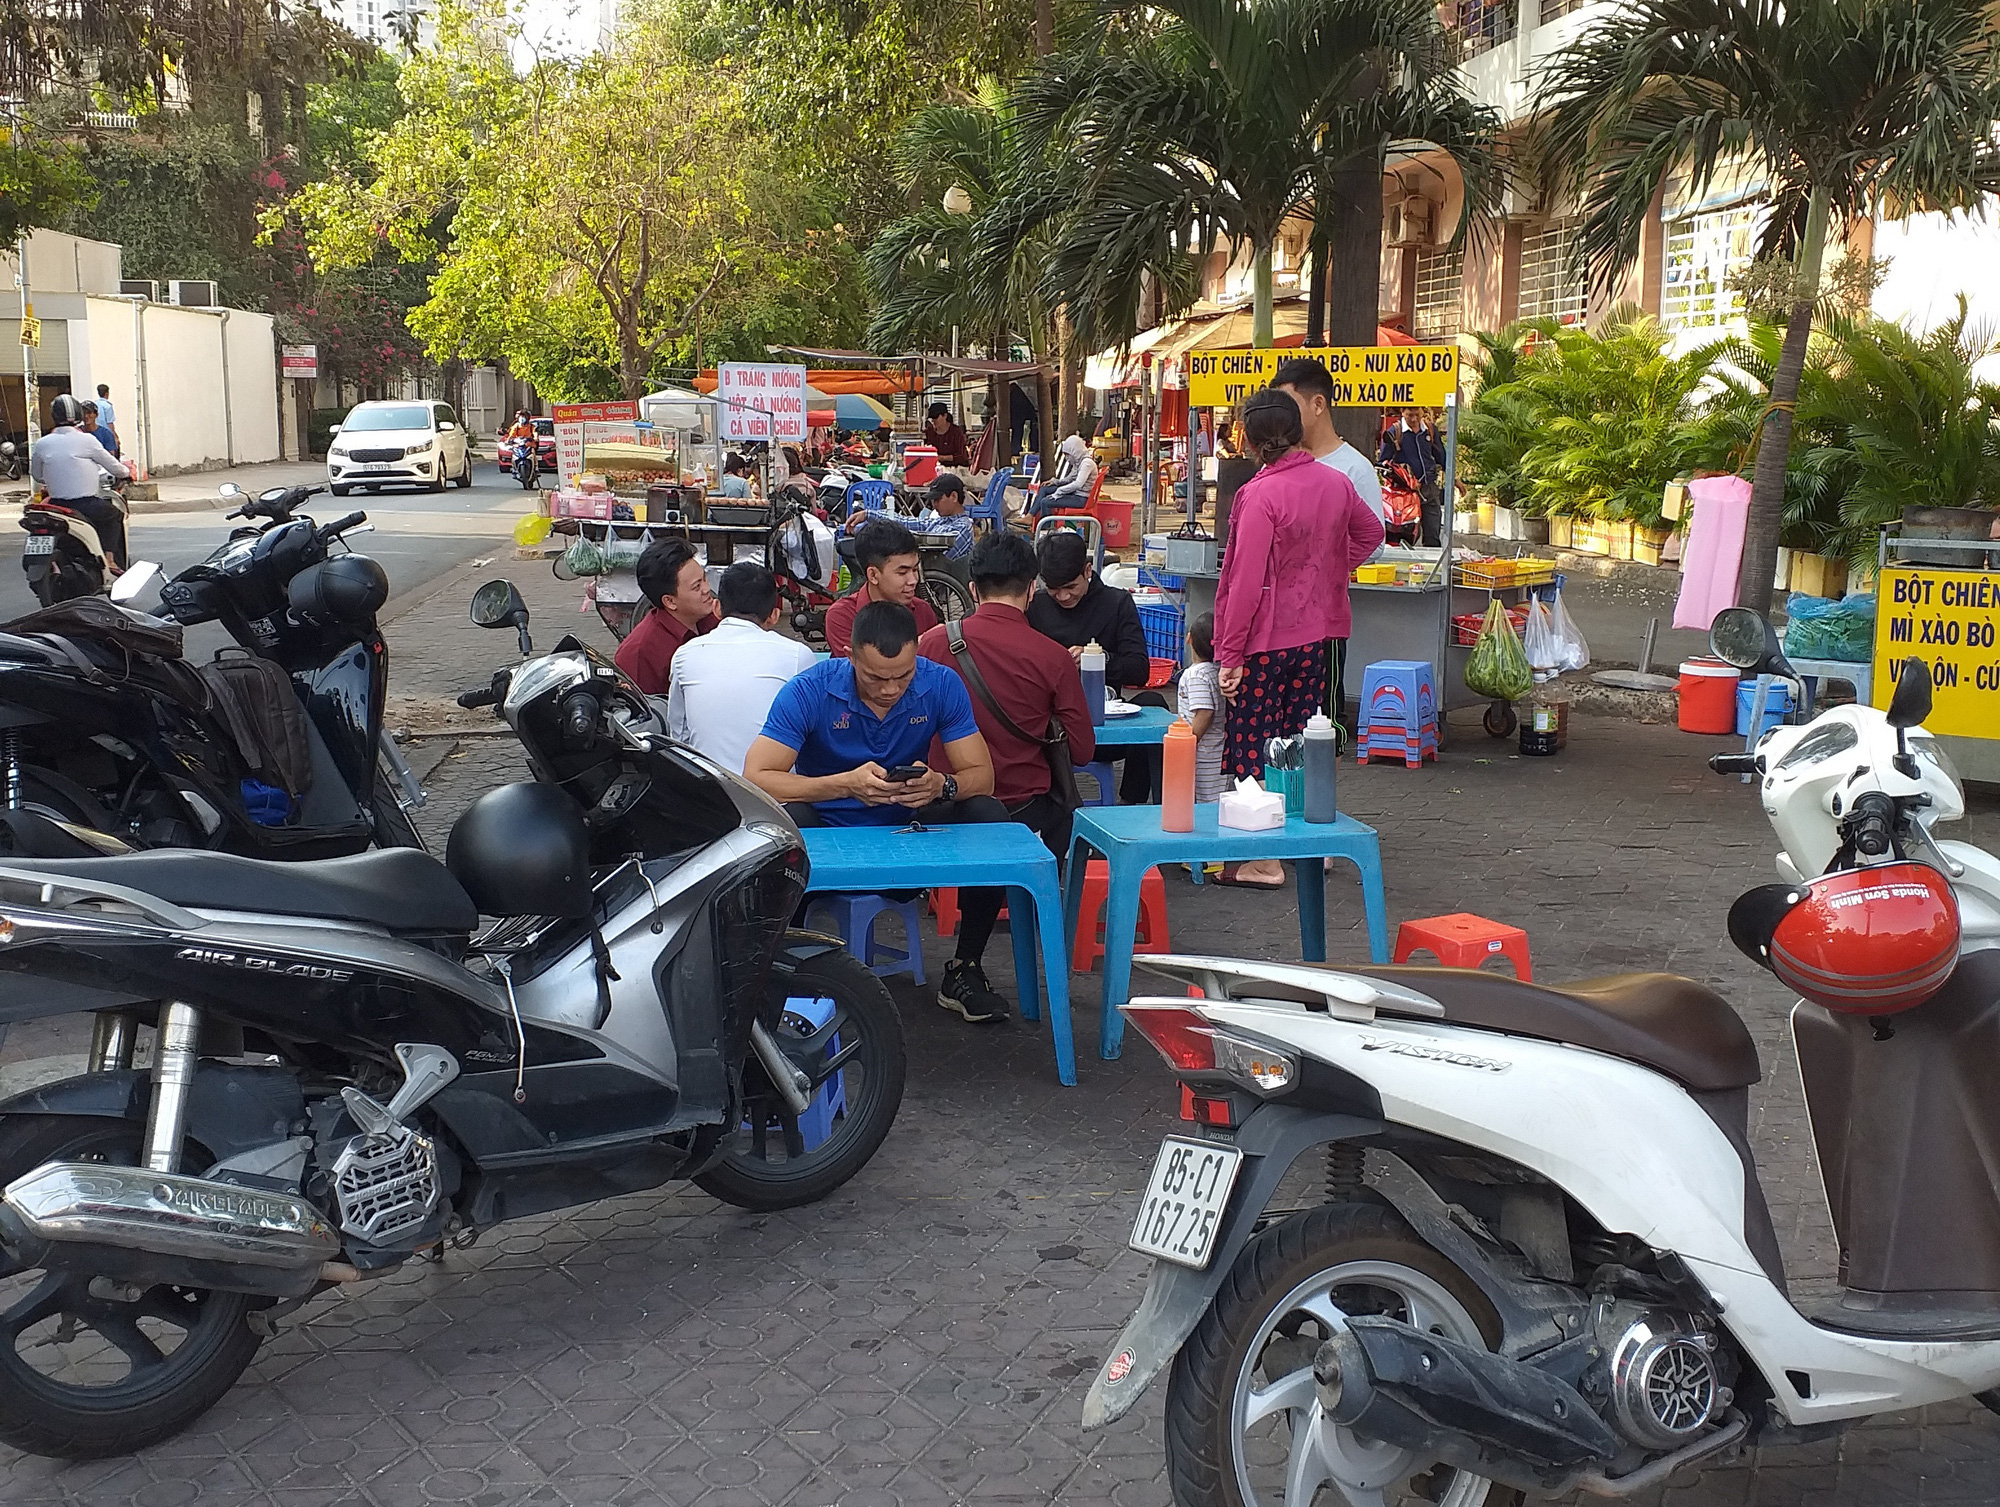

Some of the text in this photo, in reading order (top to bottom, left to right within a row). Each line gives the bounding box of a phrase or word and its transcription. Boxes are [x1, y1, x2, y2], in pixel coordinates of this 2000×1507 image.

[1192, 352, 1218, 378] BỘT
[1222, 351, 1263, 373] CHIÊN
[1330, 349, 1350, 373] BÒ
[1365, 354, 1390, 372] NUI
[1395, 348, 1426, 372] XÀO
[1431, 347, 1452, 372] BÒ
[725, 367, 800, 388] B TRÁNG NƯỚNG
[1357, 379, 1387, 402] XÀO
[1392, 384, 1414, 402] ME
[557, 409, 578, 418] Quán
[729, 391, 801, 414] HỘT GÀ NƯỚNG
[730, 416, 800, 435] CÁ VIÊN CHIÊN
[1894, 573, 2000, 609] BỘT CHIÊN
[1890, 612, 1995, 648] MÌ XÀO BÒ
[1892, 888, 1930, 898] Honda
[175, 948, 354, 981] AIR BLADE
[1358, 1034, 1513, 1072] VISION
[1209, 1132, 1234, 1141] HONDA
[1140, 1197, 1216, 1258] 167.25
